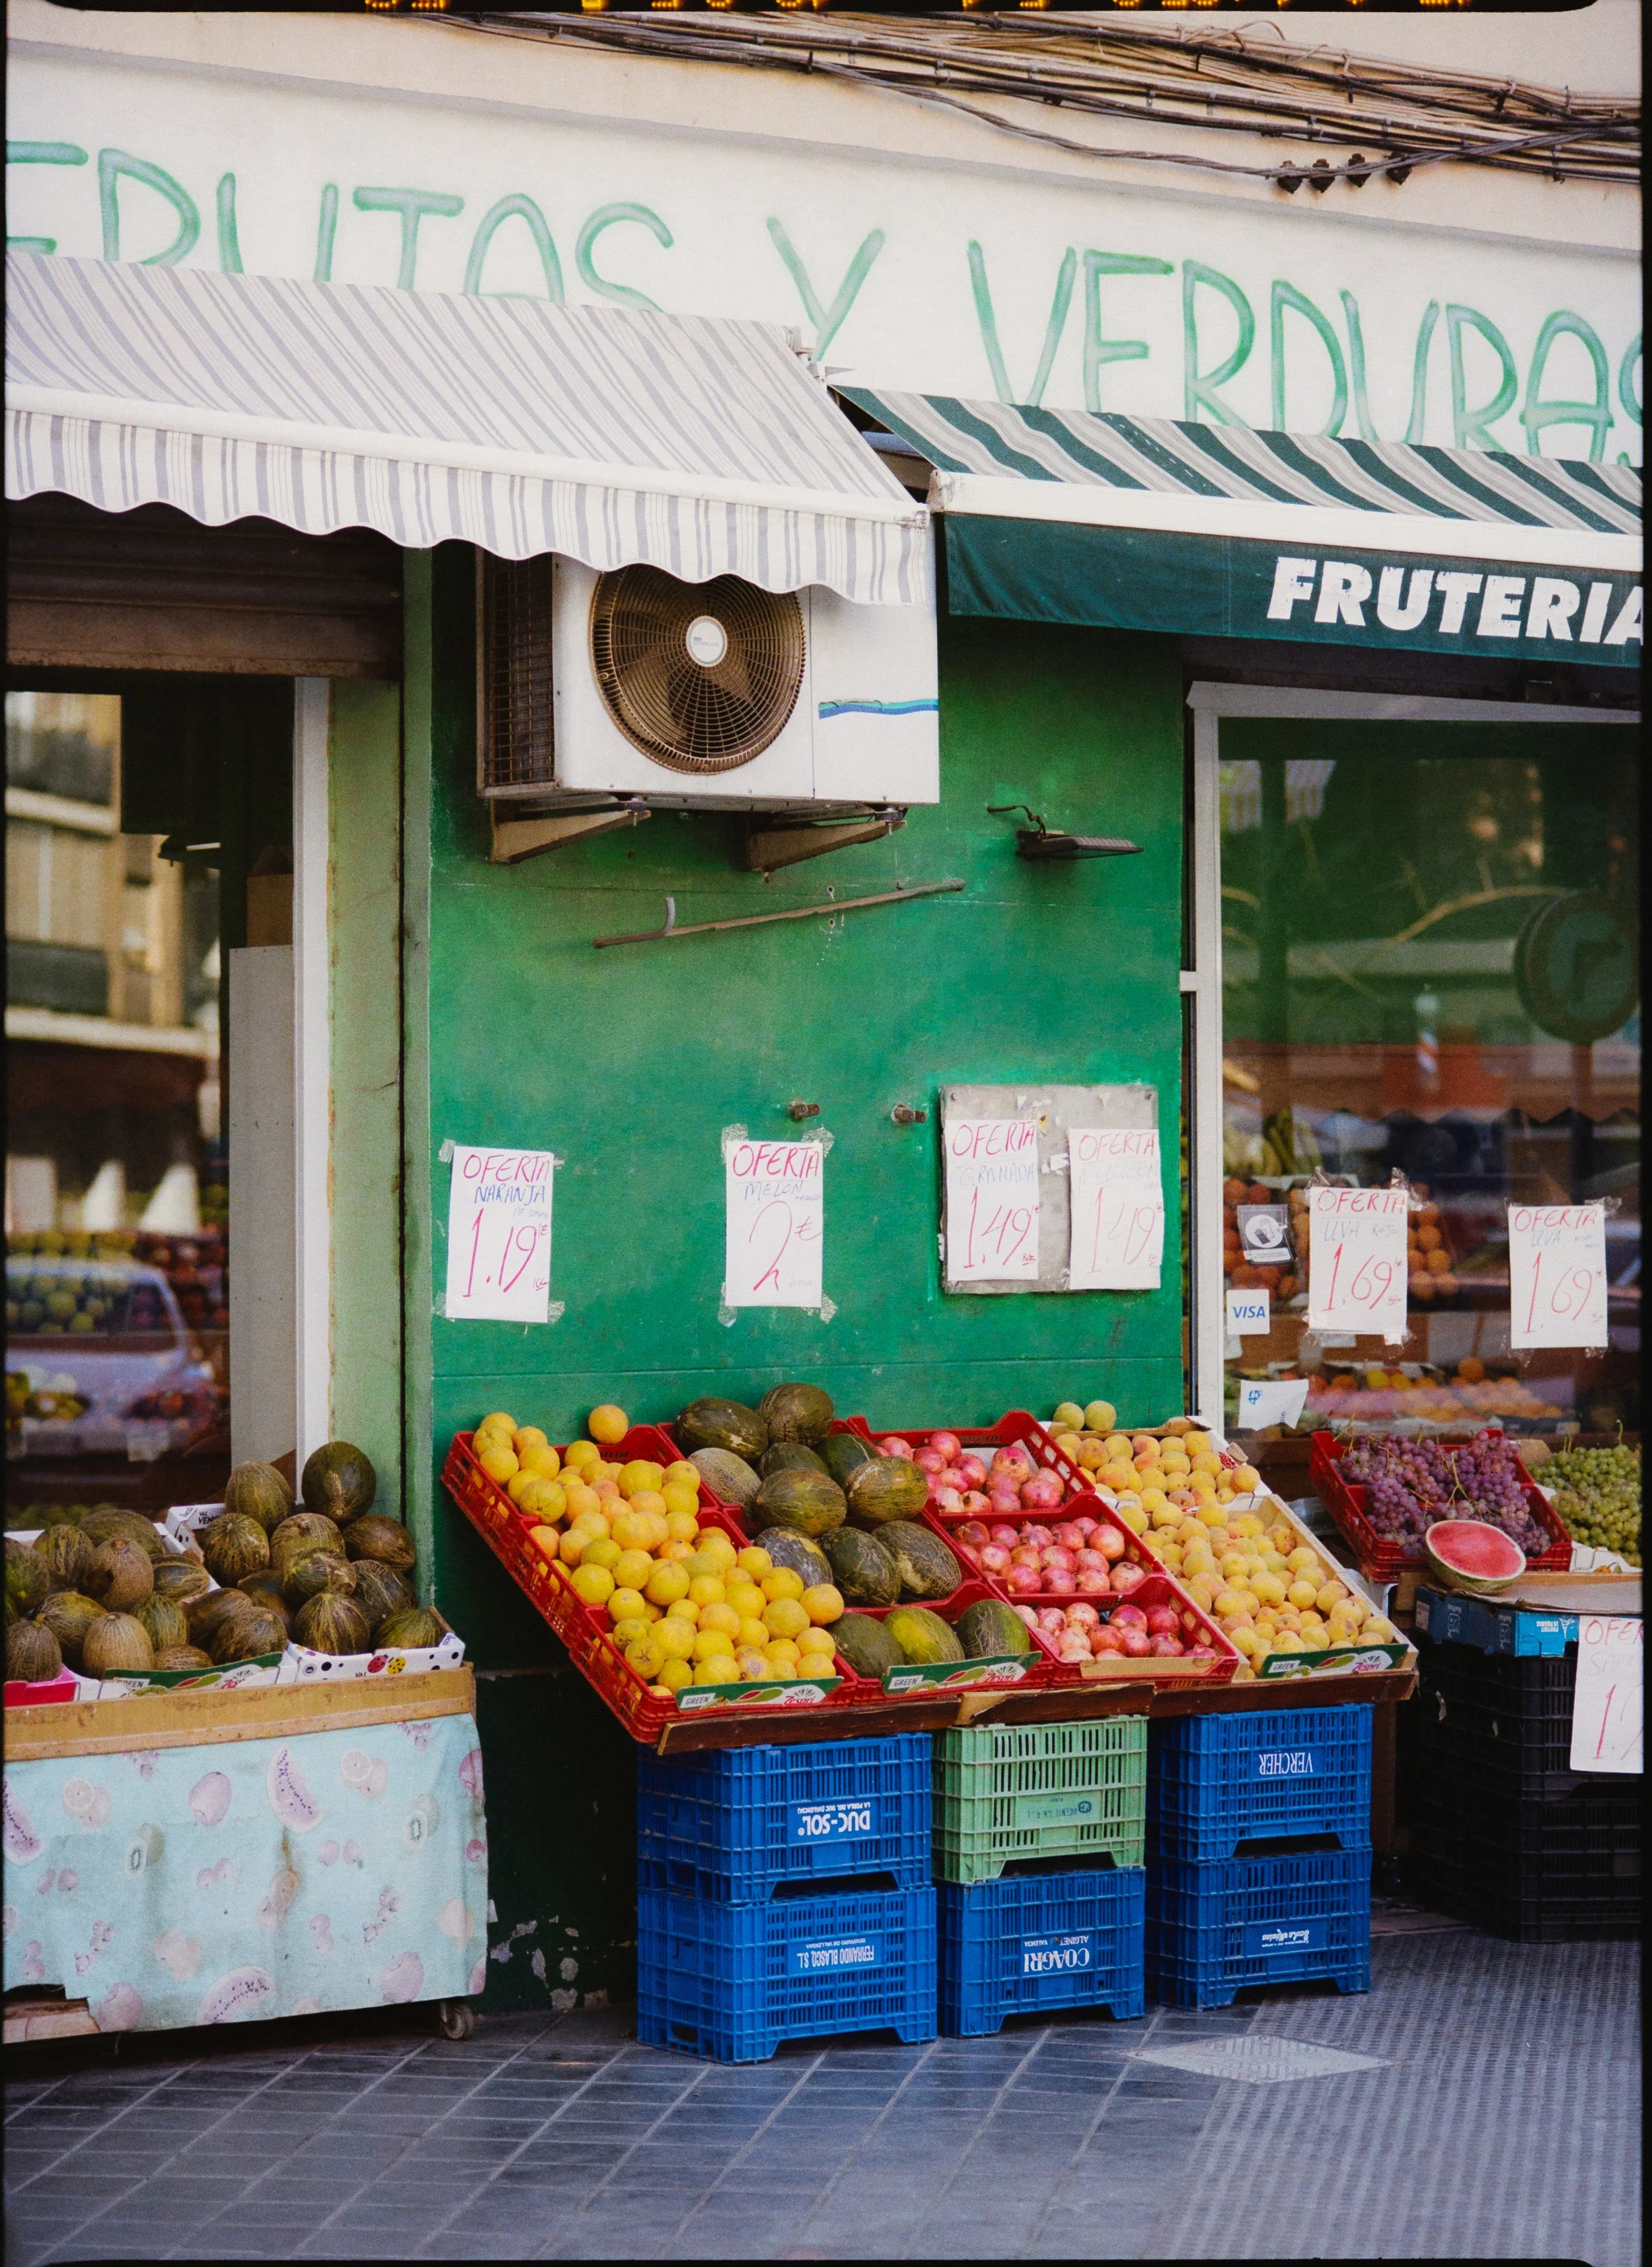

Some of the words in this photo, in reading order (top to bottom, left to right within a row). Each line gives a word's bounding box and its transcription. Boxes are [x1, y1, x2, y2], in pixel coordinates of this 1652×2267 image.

[767, 217, 885, 362] Y
[1267, 556, 1643, 646] FRUTERIA
[952, 1121, 1035, 1158] OFERTA
[1078, 1132, 1154, 1161] OFERTA
[463, 1154, 549, 1183] OFERTA
[733, 1144, 819, 1178] OFERTA
[960, 1162, 1034, 1187] GRANADA
[474, 1183, 545, 1206] NARANJA
[745, 1181, 804, 1201] MELON
[1318, 1189, 1405, 1214] OFERTA
[1324, 1220, 1359, 1241] UVA
[1515, 1208, 1597, 1232] OFERTA
[1531, 1230, 1561, 1247] UVA
[1233, 1306, 1265, 1319] VISA
[1273, 1662, 1295, 1671] GREEN
[1355, 1662, 1381, 1671] Zespri
[894, 1678, 917, 1687] GREEN
[987, 1672, 1016, 1682] Zespri
[685, 1696, 710, 1705] GREEN
[782, 1695, 815, 1705] Zespri
[1258, 1752, 1313, 1775] VERCHER
[839, 1945, 874, 1964] FERRANDO
[1024, 1948, 1090, 1972] COAGRI
